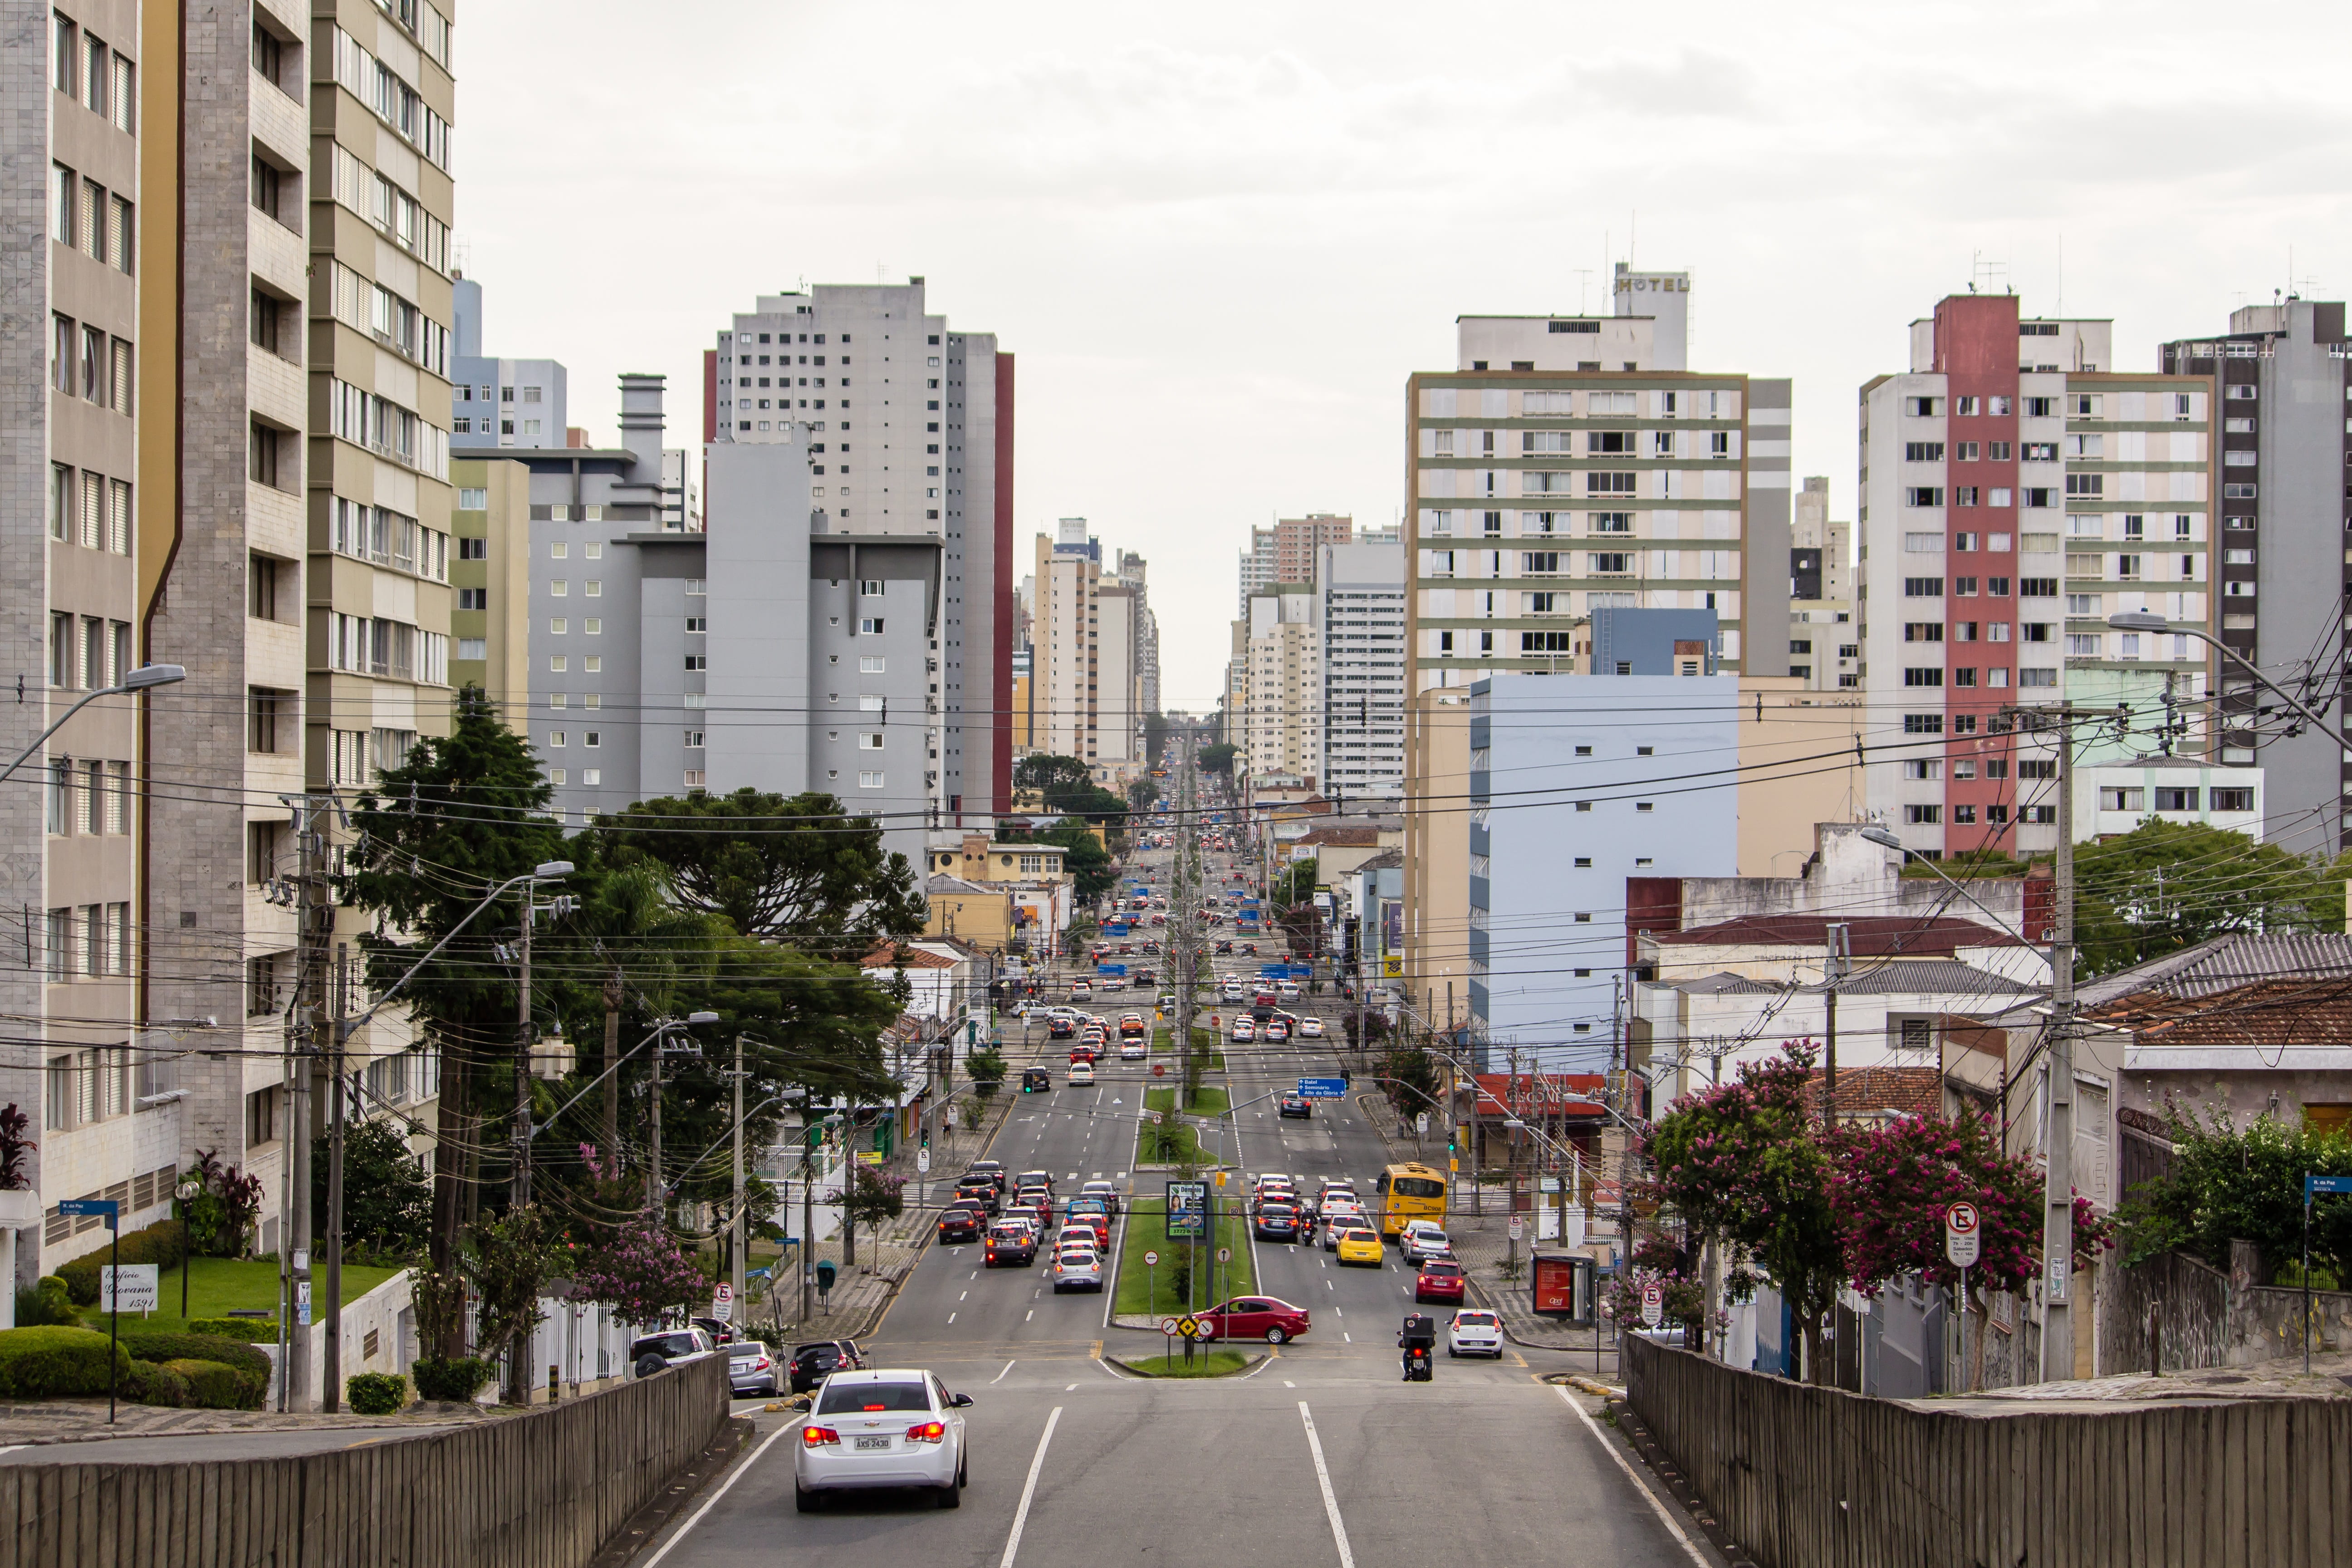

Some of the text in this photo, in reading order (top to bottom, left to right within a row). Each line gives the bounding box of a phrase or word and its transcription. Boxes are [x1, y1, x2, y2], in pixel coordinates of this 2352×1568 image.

[1619, 278, 1688, 292] HOTEL
[105, 1284, 154, 1294] Govana
[128, 1298, 154, 1308] 1591
